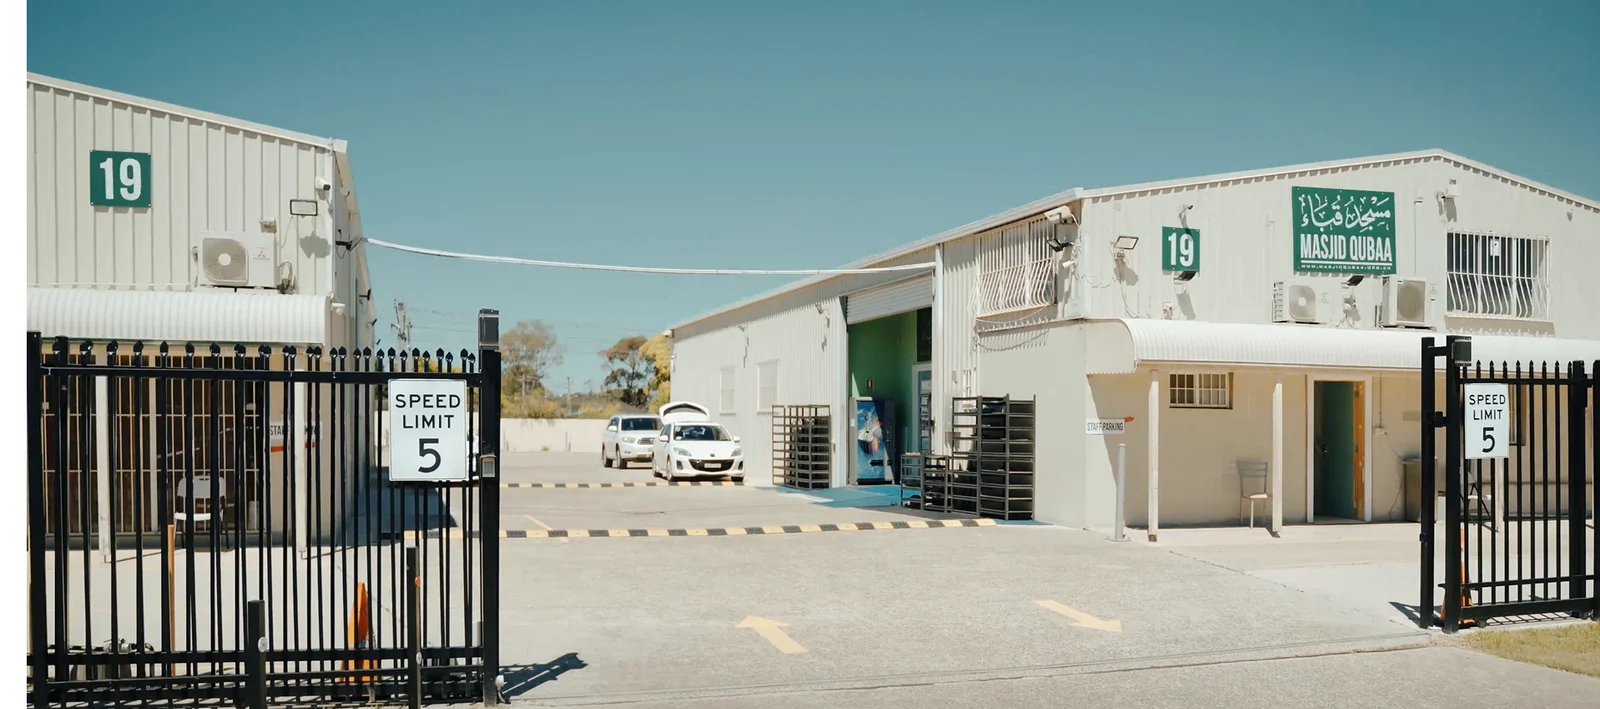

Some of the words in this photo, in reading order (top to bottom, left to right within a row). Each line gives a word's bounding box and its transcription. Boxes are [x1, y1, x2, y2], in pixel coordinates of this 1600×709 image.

[100, 157, 142, 201] 19
[1168, 232, 1194, 267] 19
[1300, 233, 1346, 260] MASJID
[1349, 235, 1393, 262] QUBAA
[395, 394, 461, 409] SPEED
[1469, 394, 1506, 405] SPEED
[403, 414, 454, 429] LIMIT
[1473, 409, 1503, 420] LIMIT
[1087, 422, 1102, 431] STAFF
[1102, 422, 1124, 431] PARKING
[1482, 427, 1495, 453] 5
[418, 438, 441, 473] 5
